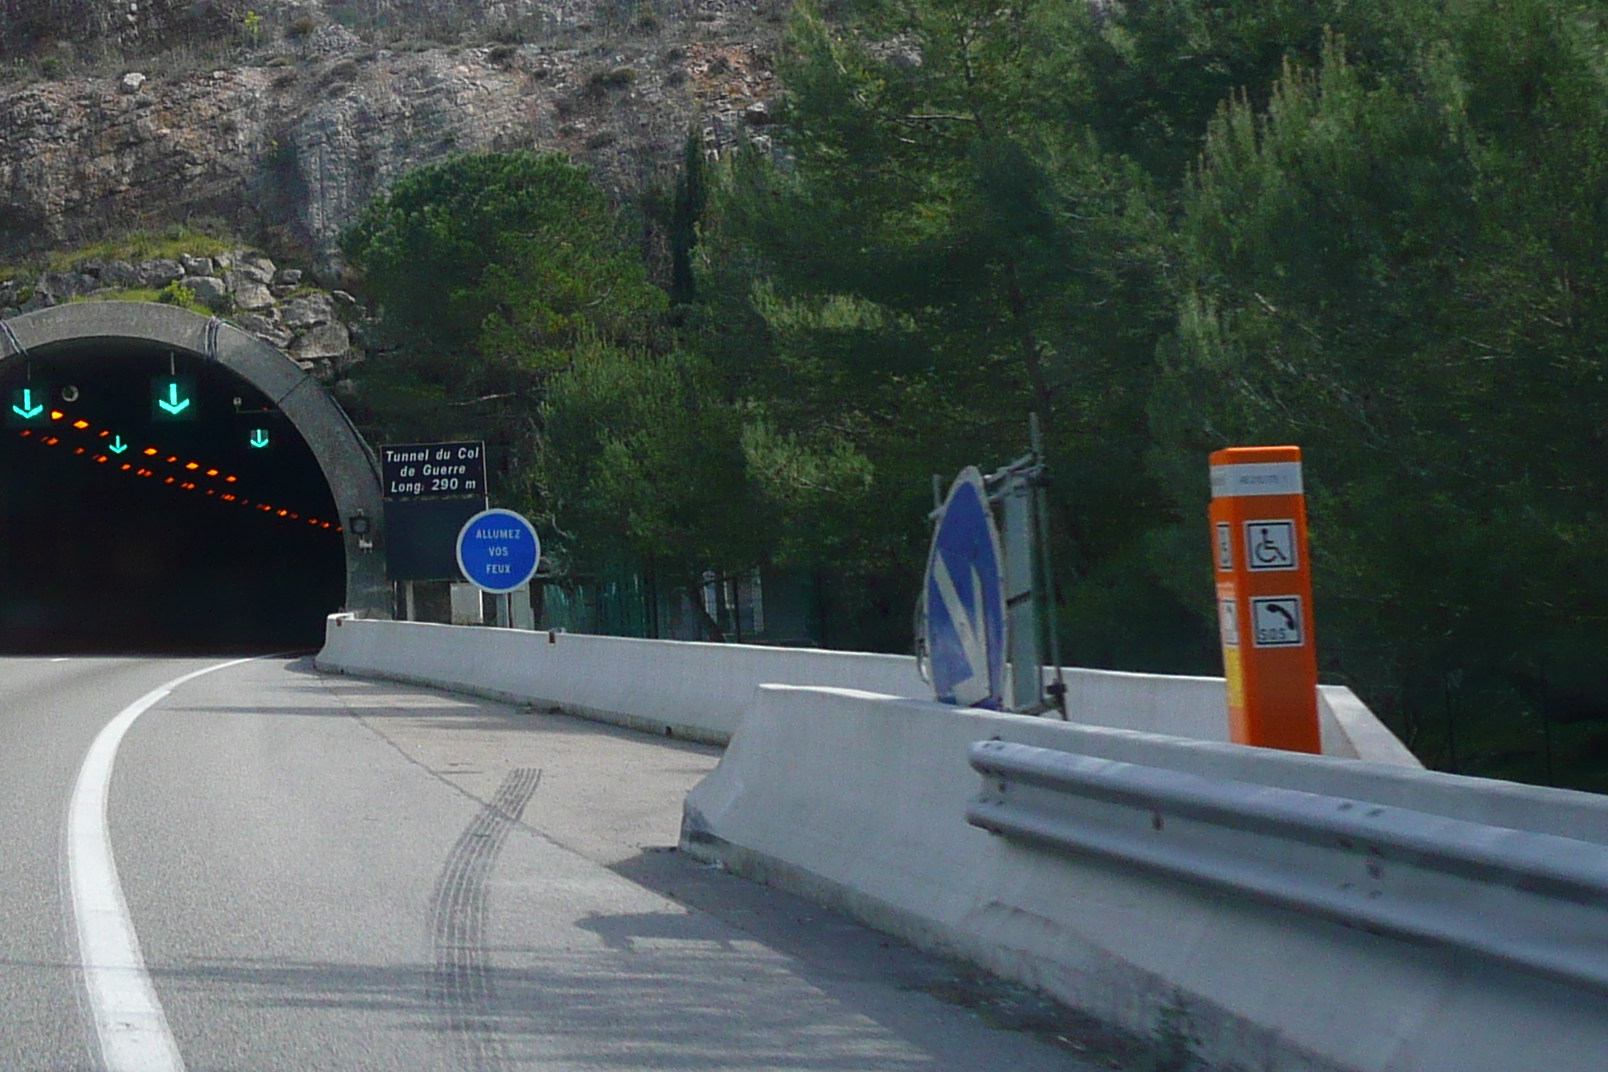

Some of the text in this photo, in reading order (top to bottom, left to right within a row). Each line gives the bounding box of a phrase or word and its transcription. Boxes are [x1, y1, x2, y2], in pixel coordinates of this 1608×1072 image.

[386, 447, 479, 463] Tunnel du Col
[400, 464, 466, 477] de Guerre
[432, 478, 458, 491] 290
[465, 480, 476, 490] m
[476, 529, 521, 539] ALLUMEZ
[488, 547, 509, 557] VOS
[486, 564, 511, 574] FEUX
